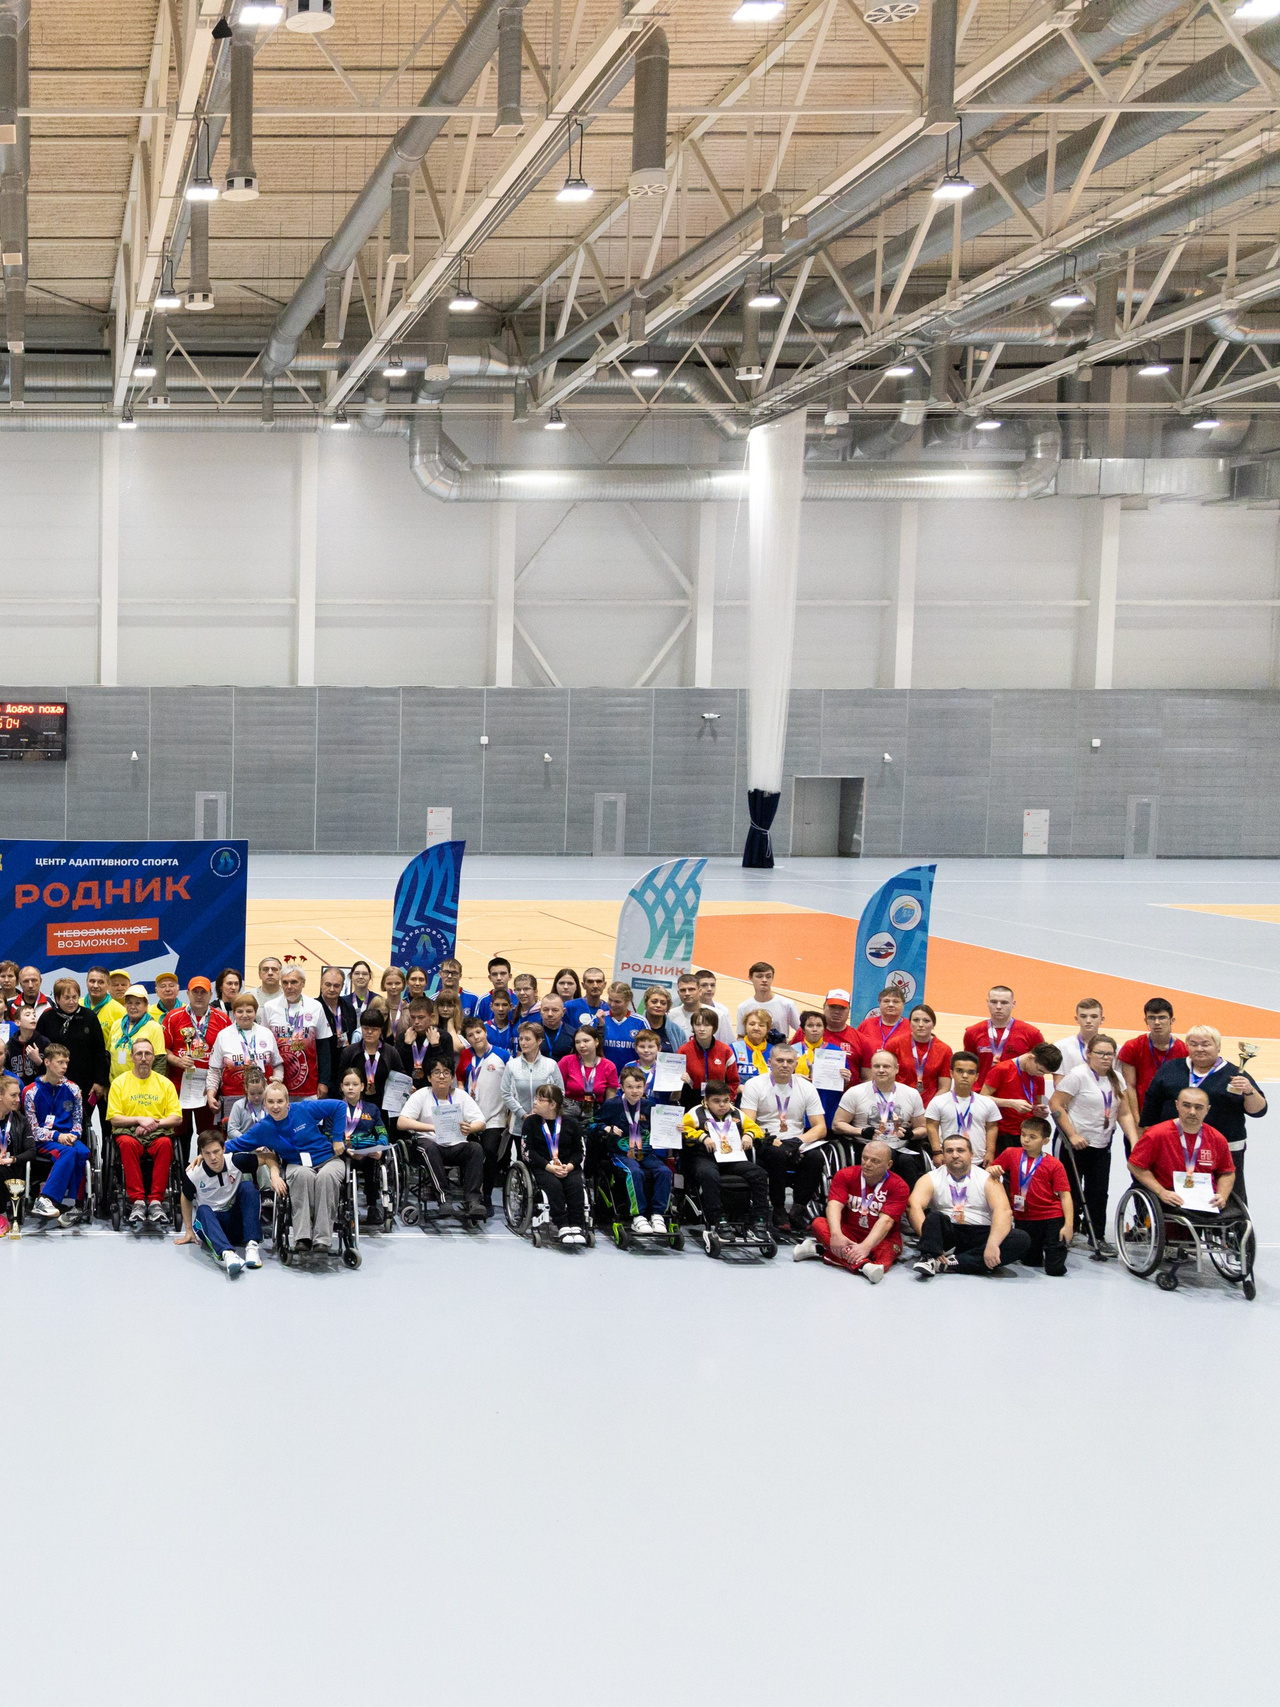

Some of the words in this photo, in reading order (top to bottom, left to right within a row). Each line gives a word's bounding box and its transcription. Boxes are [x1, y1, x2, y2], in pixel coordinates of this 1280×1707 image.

[35, 858, 67, 867] ЦЕНТР
[68, 858, 140, 867] АДАПТИВНОГО
[141, 858, 179, 867] СПОРТА
[15, 875, 191, 910] РОДНИК
[56, 925, 149, 938] НЕВОЗМОЖНОЕ
[57, 938, 128, 949] ВОЗМОЖНО.
[621, 962, 686, 976] РОДНИК
